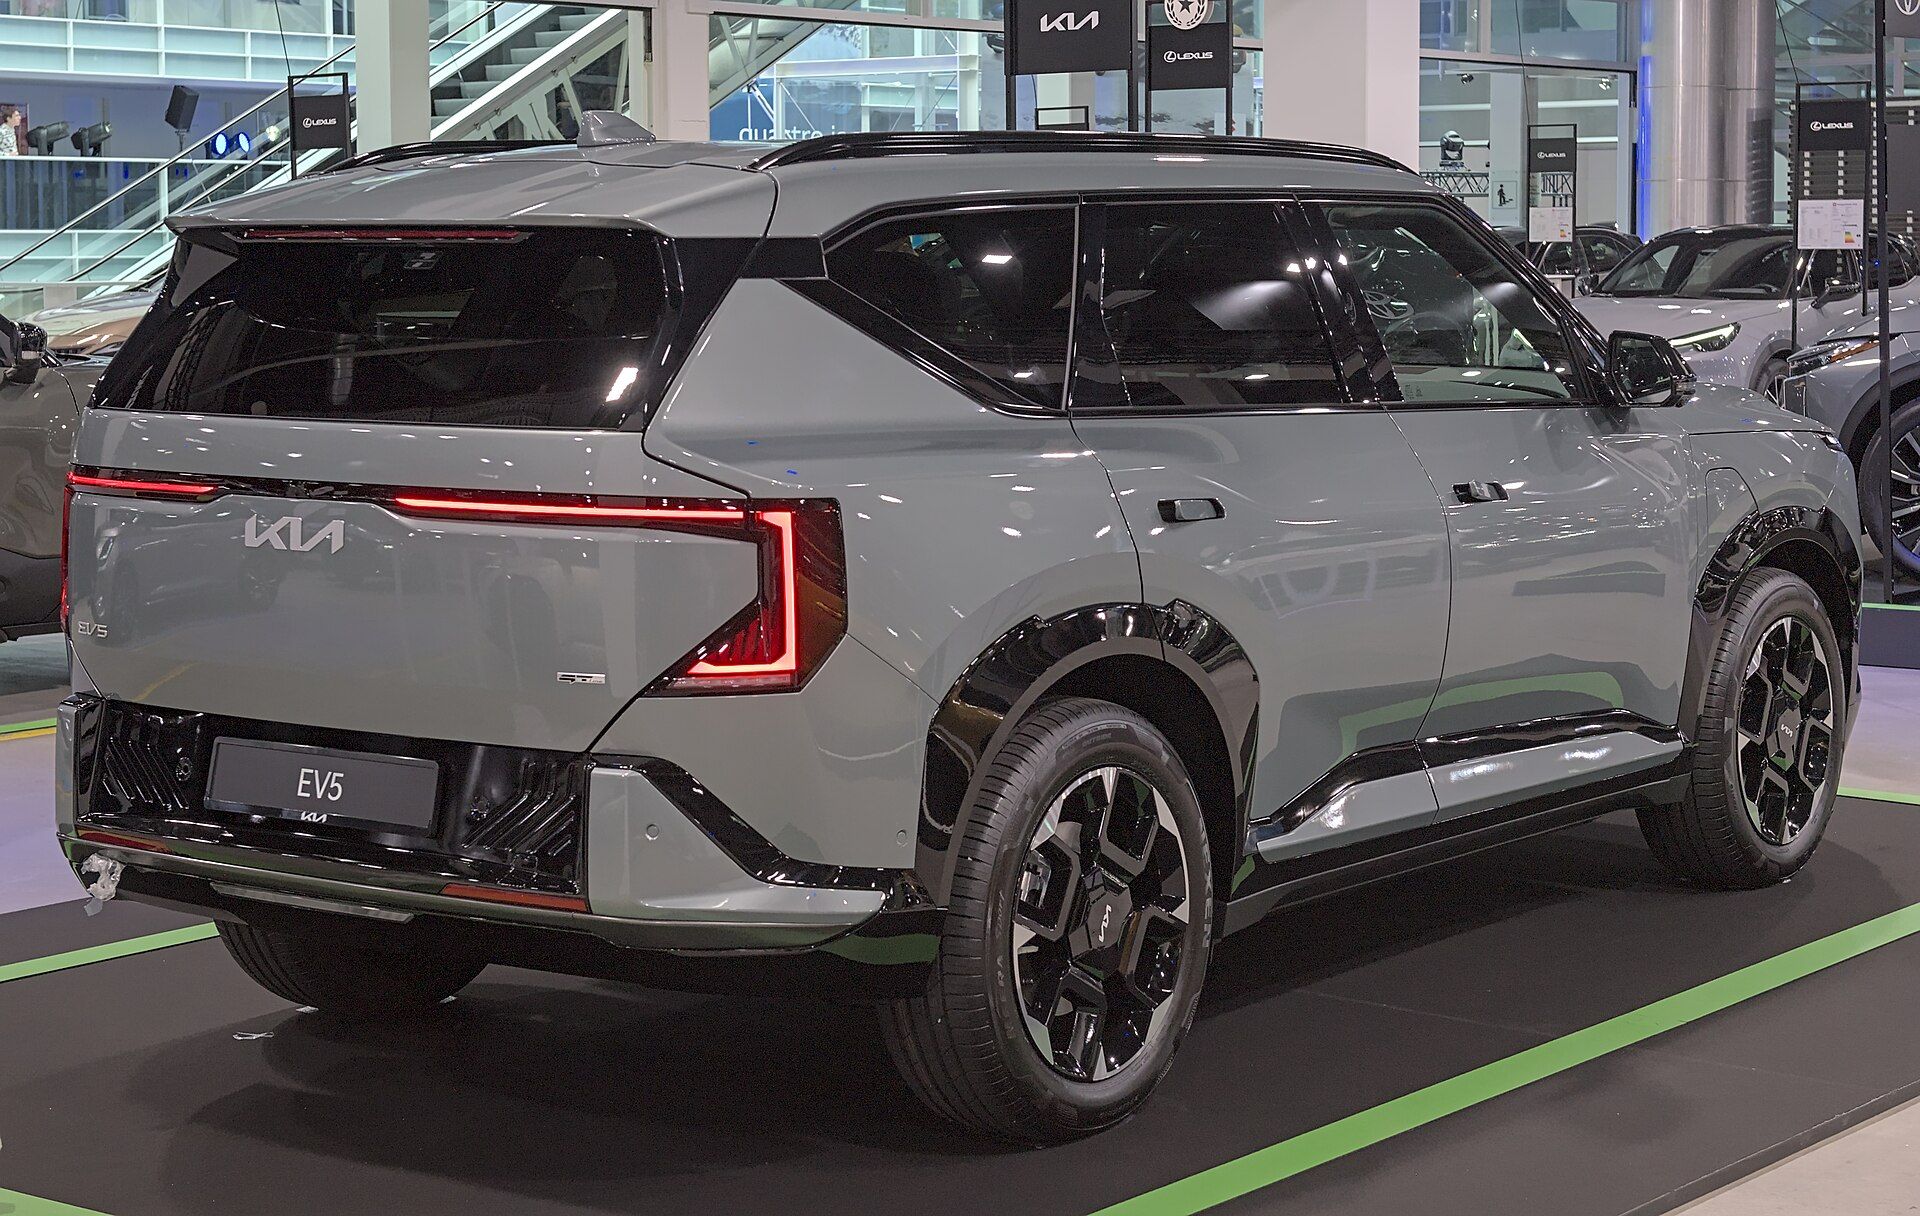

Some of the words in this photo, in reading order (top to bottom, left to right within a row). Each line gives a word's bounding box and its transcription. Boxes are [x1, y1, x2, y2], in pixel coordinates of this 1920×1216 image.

[1040, 10, 1099, 33] KIA
[1176, 51, 1214, 60] LEXUS
[312, 118, 337, 126] LEXUS
[739, 126, 823, 141] quatro
[245, 513, 345, 554] KIA
[78, 621, 108, 638] EV5
[297, 768, 344, 801] EV5
[300, 811, 328, 823] KIA
